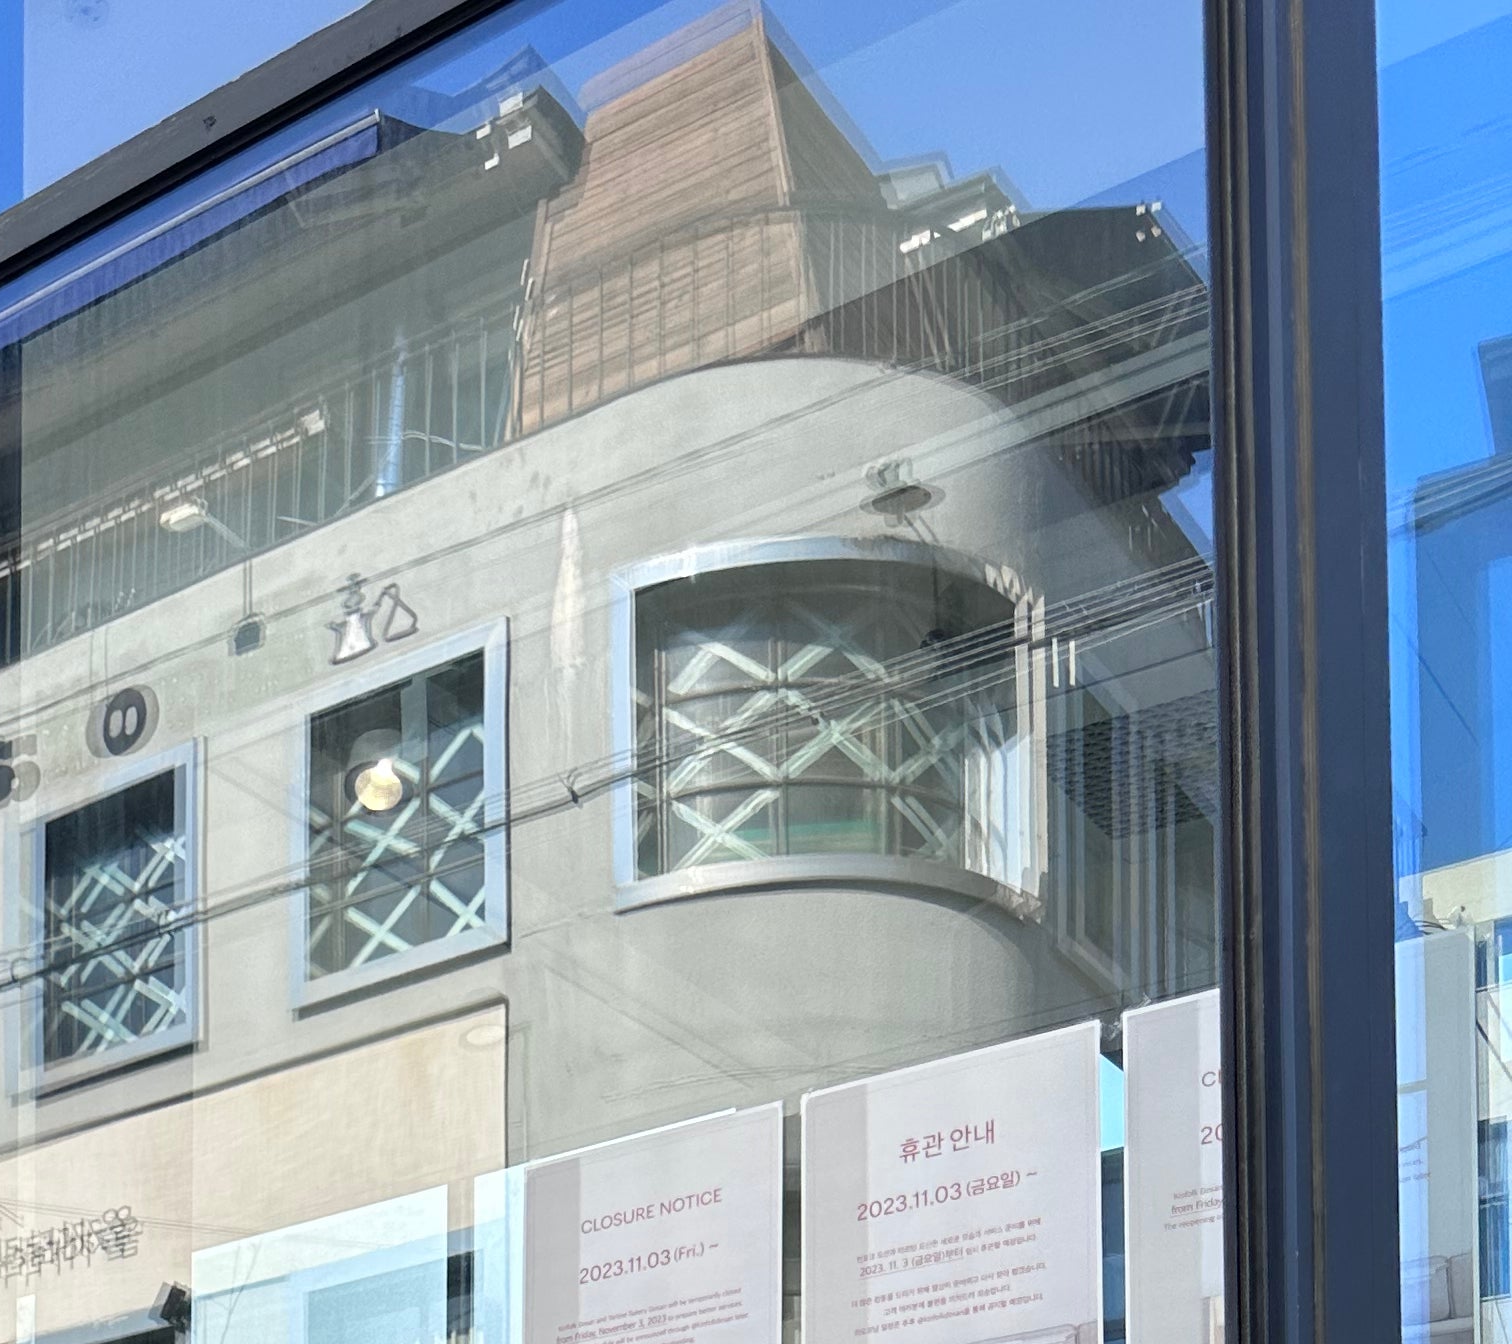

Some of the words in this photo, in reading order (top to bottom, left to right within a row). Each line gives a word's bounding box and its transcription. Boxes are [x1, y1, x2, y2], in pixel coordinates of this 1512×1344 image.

[899, 1131, 944, 1164] 휴관
[950, 1118, 995, 1152] 안내
[581, 1204, 656, 1234] CLOSURE
[660, 1188, 723, 1216] NOTICE
[857, 1182, 962, 1221] 2023.11.03
[966, 1170, 1021, 1197] (금요일)
[579, 1249, 671, 1284] 2023.11.03
[674, 1241, 705, 1262] (Fri.)
[598, 1321, 636, 1335] November
